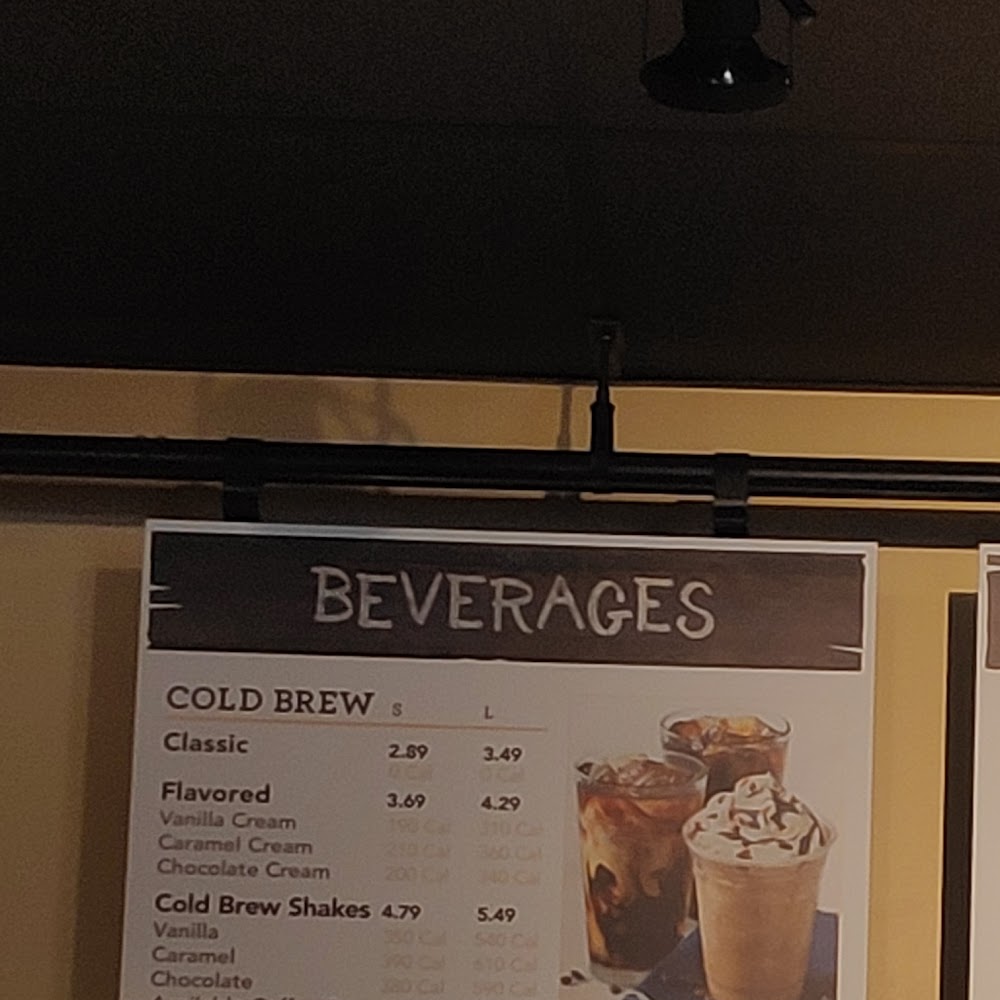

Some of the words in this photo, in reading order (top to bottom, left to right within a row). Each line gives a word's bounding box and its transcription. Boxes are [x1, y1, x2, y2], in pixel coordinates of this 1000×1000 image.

[310, 565, 715, 640] BEVERAGES
[166, 686, 264, 713] COLD
[273, 688, 375, 716] BREW
[163, 732, 249, 755] Classic
[388, 743, 429, 760] 2.89
[483, 746, 522, 763] 3.49
[160, 781, 271, 803] Flavored
[386, 793, 426, 809] 3.69
[481, 796, 521, 812] 4.29
[160, 810, 225, 828] Vanilla
[231, 813, 297, 830] Cream
[158, 834, 241, 853] Caramel
[248, 837, 313, 855] Cream
[156, 858, 259, 878] Chocolate
[265, 862, 331, 881] Cream
[155, 894, 210, 914] Cold
[218, 896, 281, 917] Brew
[288, 897, 371, 919] Shakes
[381, 904, 421, 921] 4.79
[477, 906, 517, 924] 5.49
[153, 922, 219, 941] Vanilla
[152, 946, 236, 965] Caramel
[150, 970, 253, 990] Chocolate
